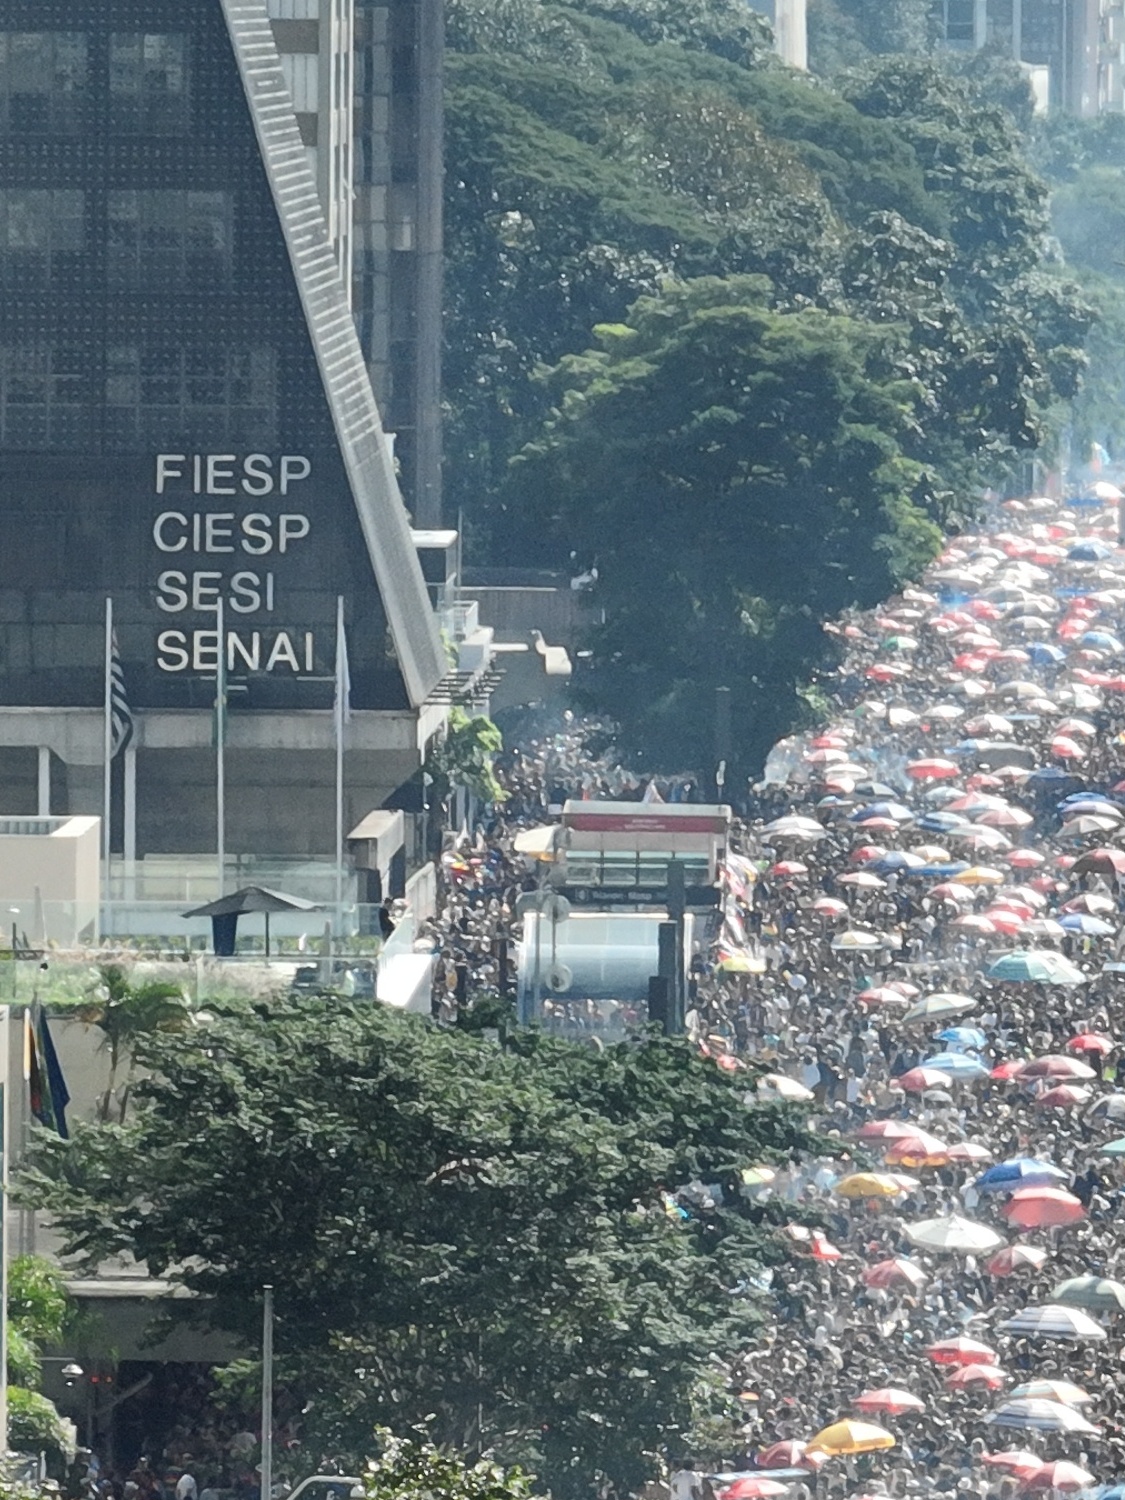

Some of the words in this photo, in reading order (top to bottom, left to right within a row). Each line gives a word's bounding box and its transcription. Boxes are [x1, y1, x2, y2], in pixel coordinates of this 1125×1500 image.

[155, 453, 311, 496] FIESP
[153, 511, 310, 555] CIESP
[156, 570, 274, 613] SESI
[157, 630, 313, 671] SENAI
